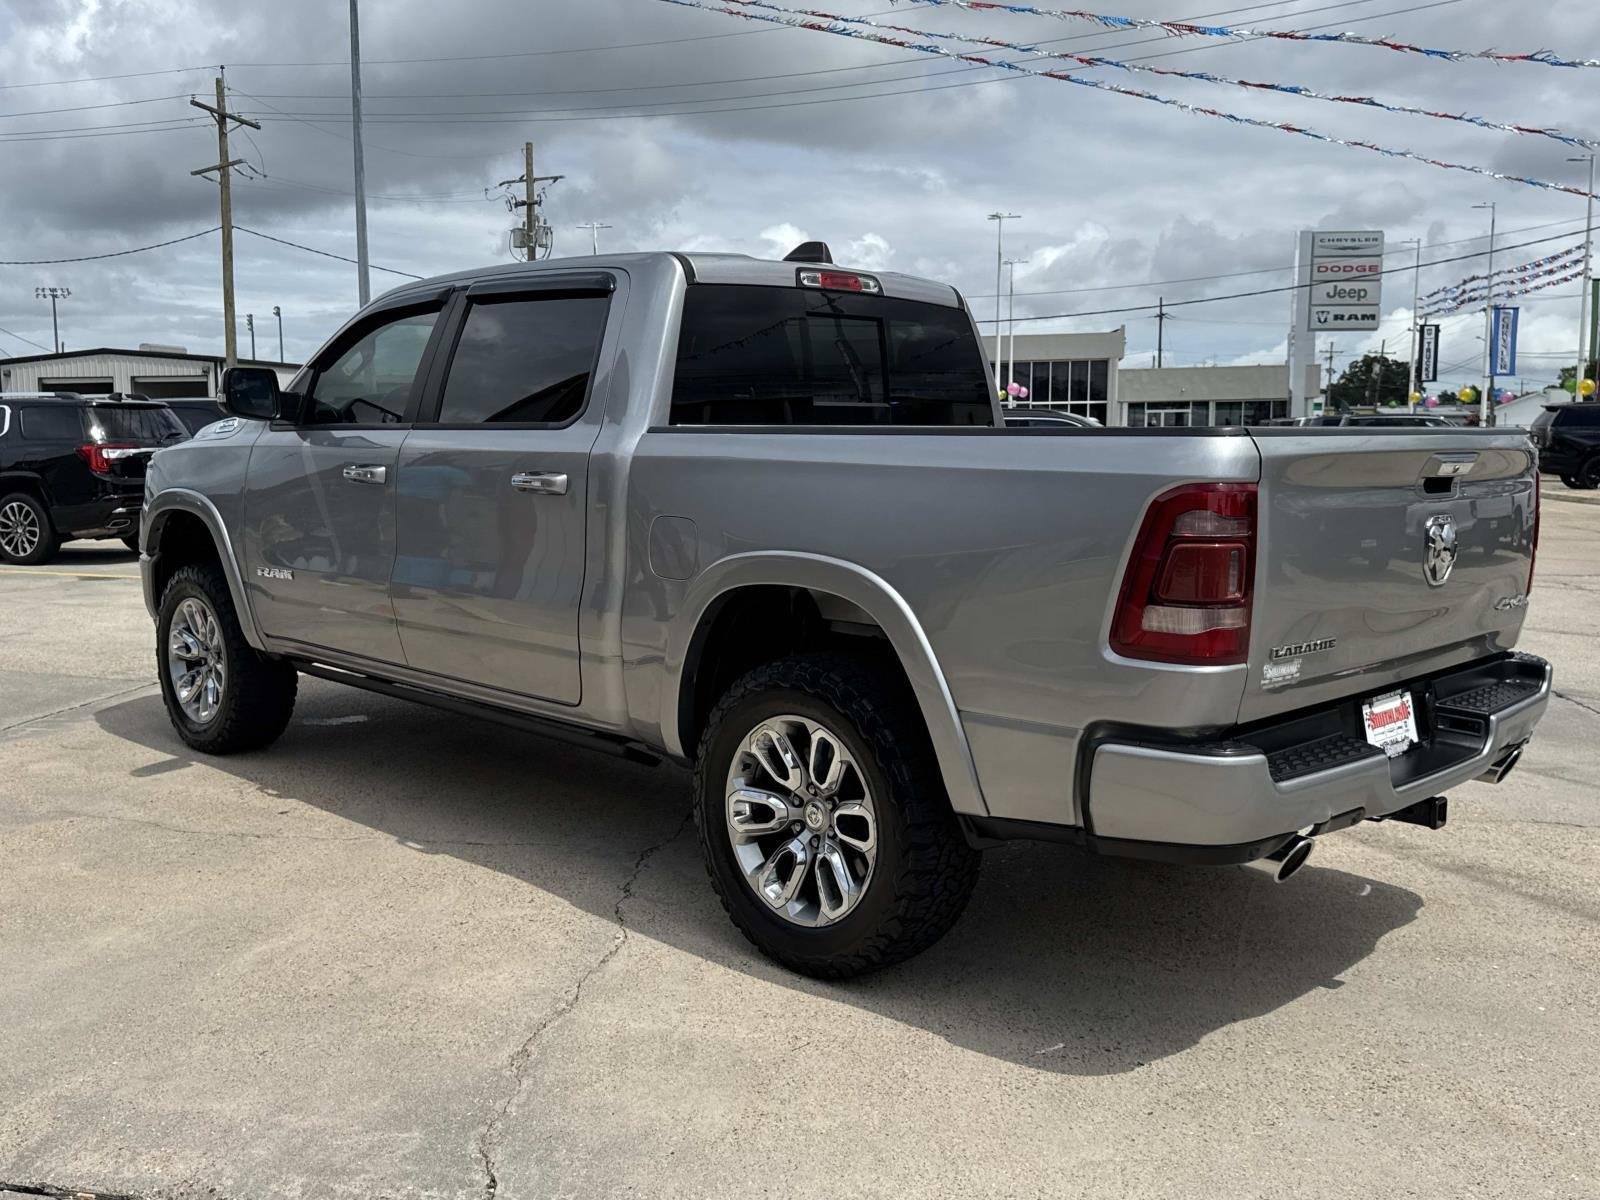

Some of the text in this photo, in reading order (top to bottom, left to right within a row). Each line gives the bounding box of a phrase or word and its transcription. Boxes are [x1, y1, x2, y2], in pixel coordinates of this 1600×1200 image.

[1317, 265, 1379, 273] DODGE
[1326, 285, 1368, 301] Jeep
[257, 566, 293, 580] RAM
[1272, 637, 1337, 659] LARAMIE
